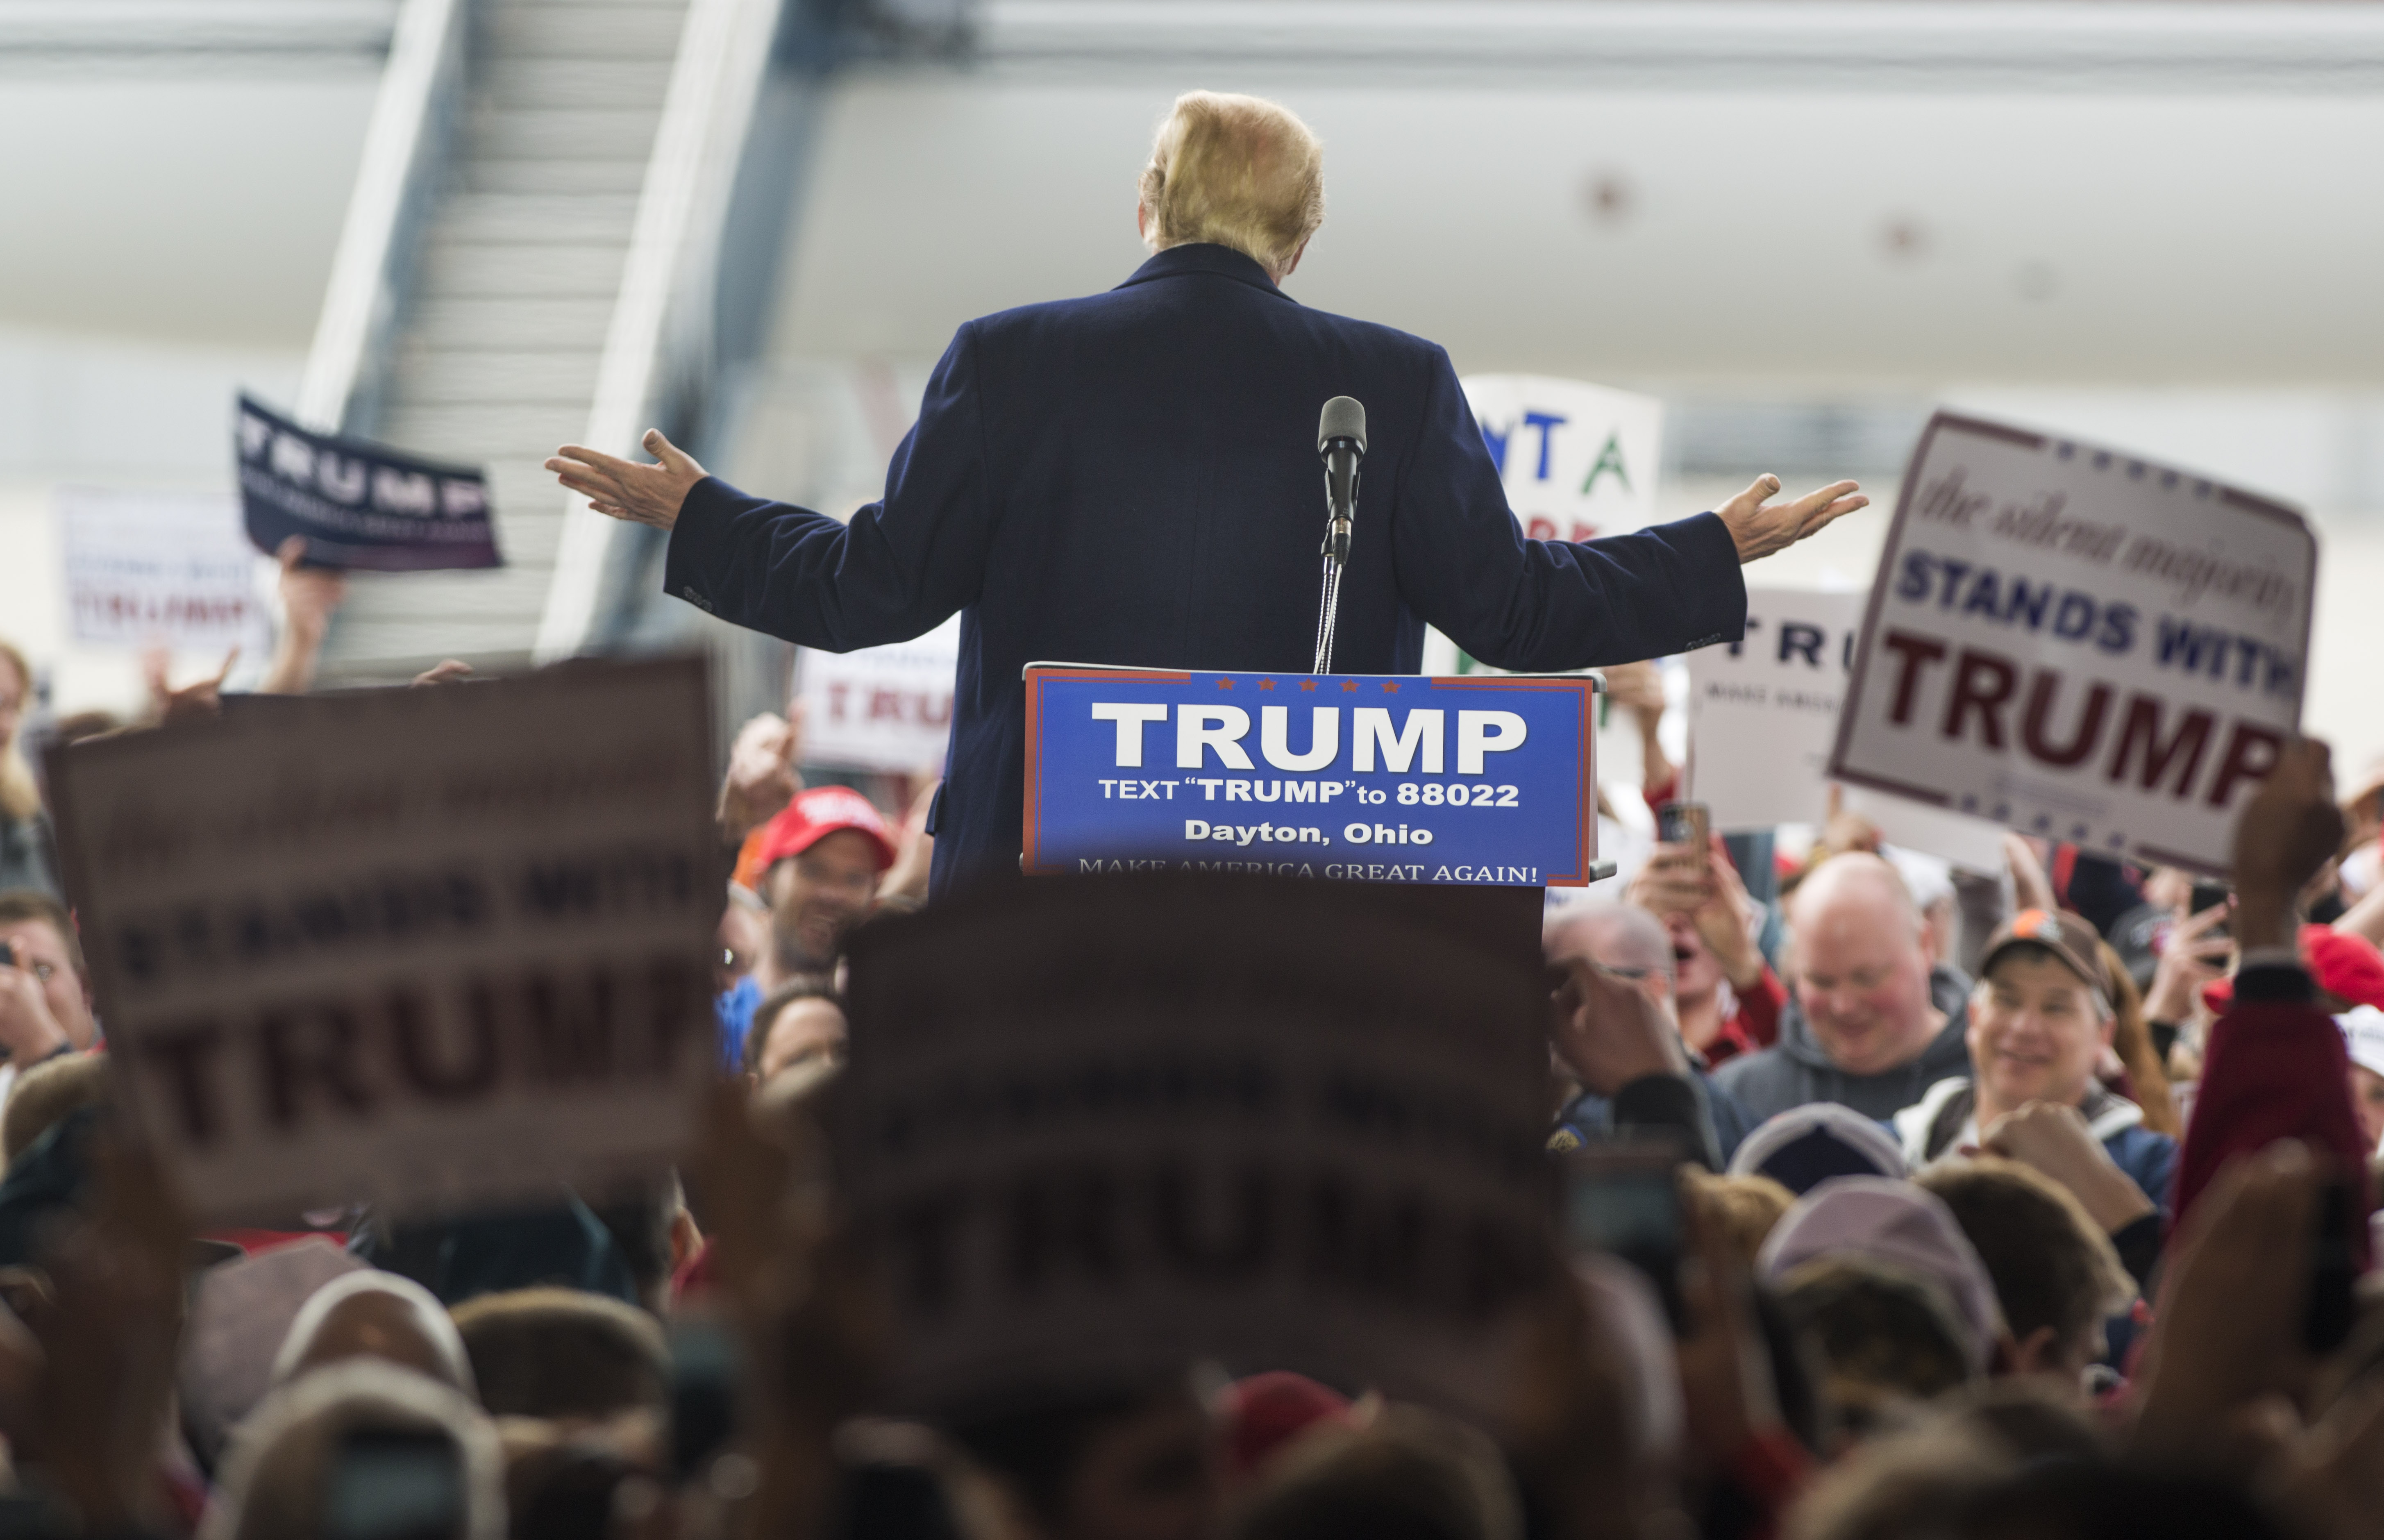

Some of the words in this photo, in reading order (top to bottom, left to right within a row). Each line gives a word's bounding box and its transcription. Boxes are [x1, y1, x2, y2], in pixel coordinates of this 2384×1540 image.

[238, 410, 485, 517] TRUMP
[1896, 548, 2140, 654] STANDS
[1092, 702, 1527, 775] TRUMP
[1885, 626, 2283, 808] TRUMP
[1099, 779, 1179, 800] TEXT
[1357, 786, 1387, 804] to
[1396, 783, 1519, 807] 88022
[1185, 820, 1330, 846] Dayton,
[1344, 822, 1433, 845] Ohio
[1079, 859, 1166, 873] MAKE
[1325, 863, 1425, 881] GREAT
[1432, 865, 1537, 883] AGAIN!
